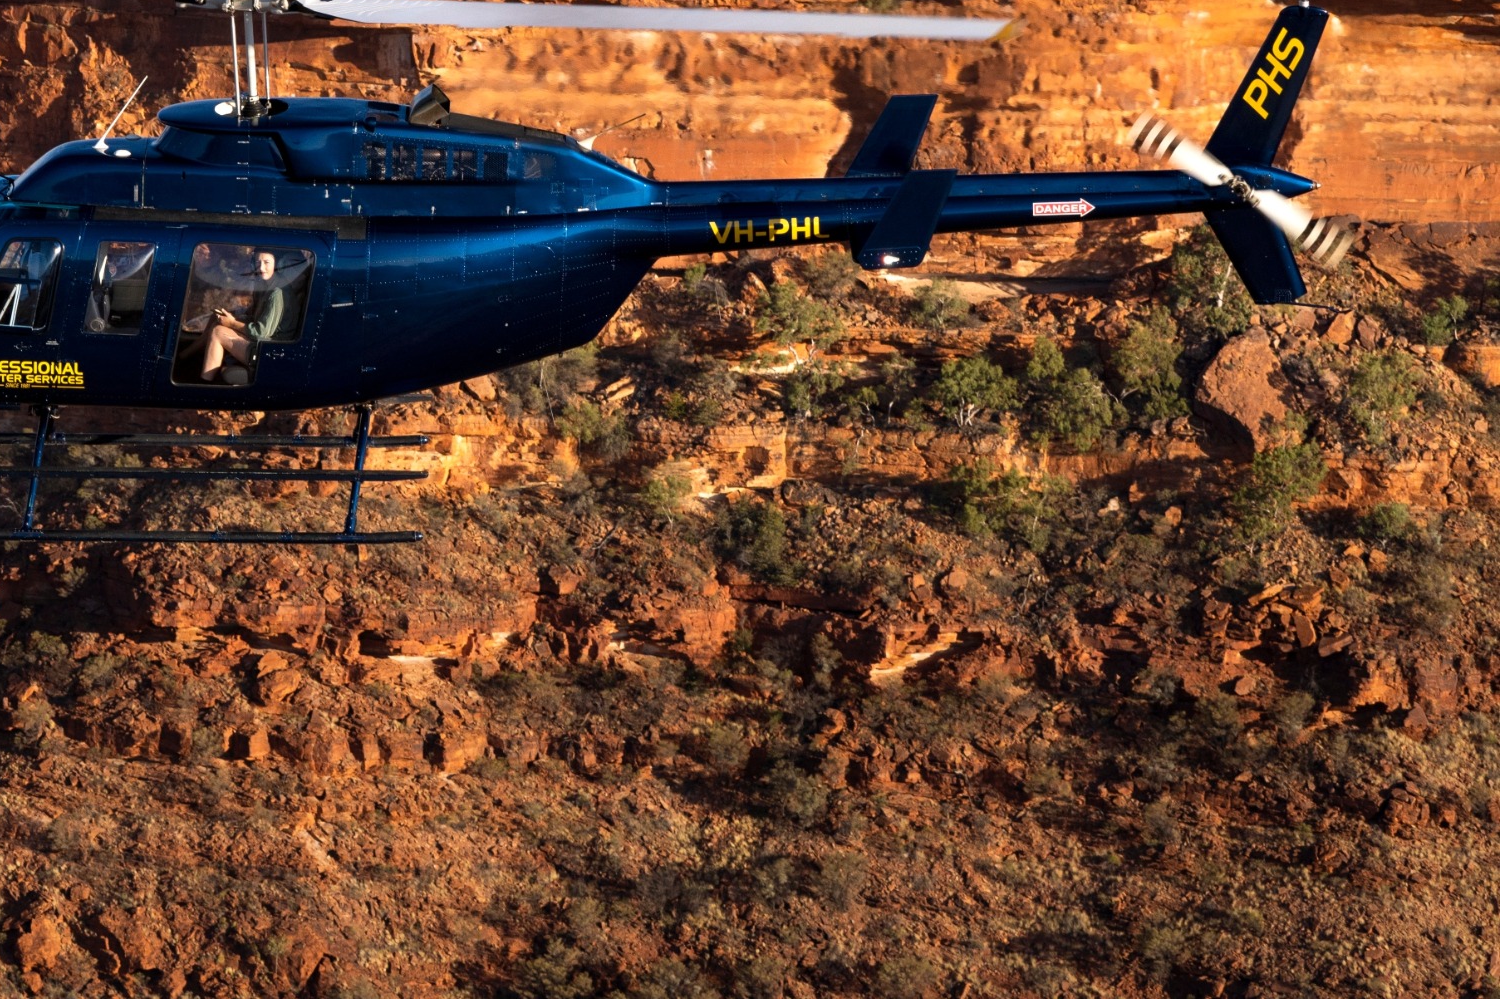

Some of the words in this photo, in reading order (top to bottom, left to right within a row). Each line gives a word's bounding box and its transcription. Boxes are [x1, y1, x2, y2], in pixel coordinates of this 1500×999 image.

[1242, 26, 1305, 120] PHS
[1035, 204, 1087, 214] DANGER
[708, 216, 830, 243] VH-PHL
[26, 374, 84, 384] SERVICES
